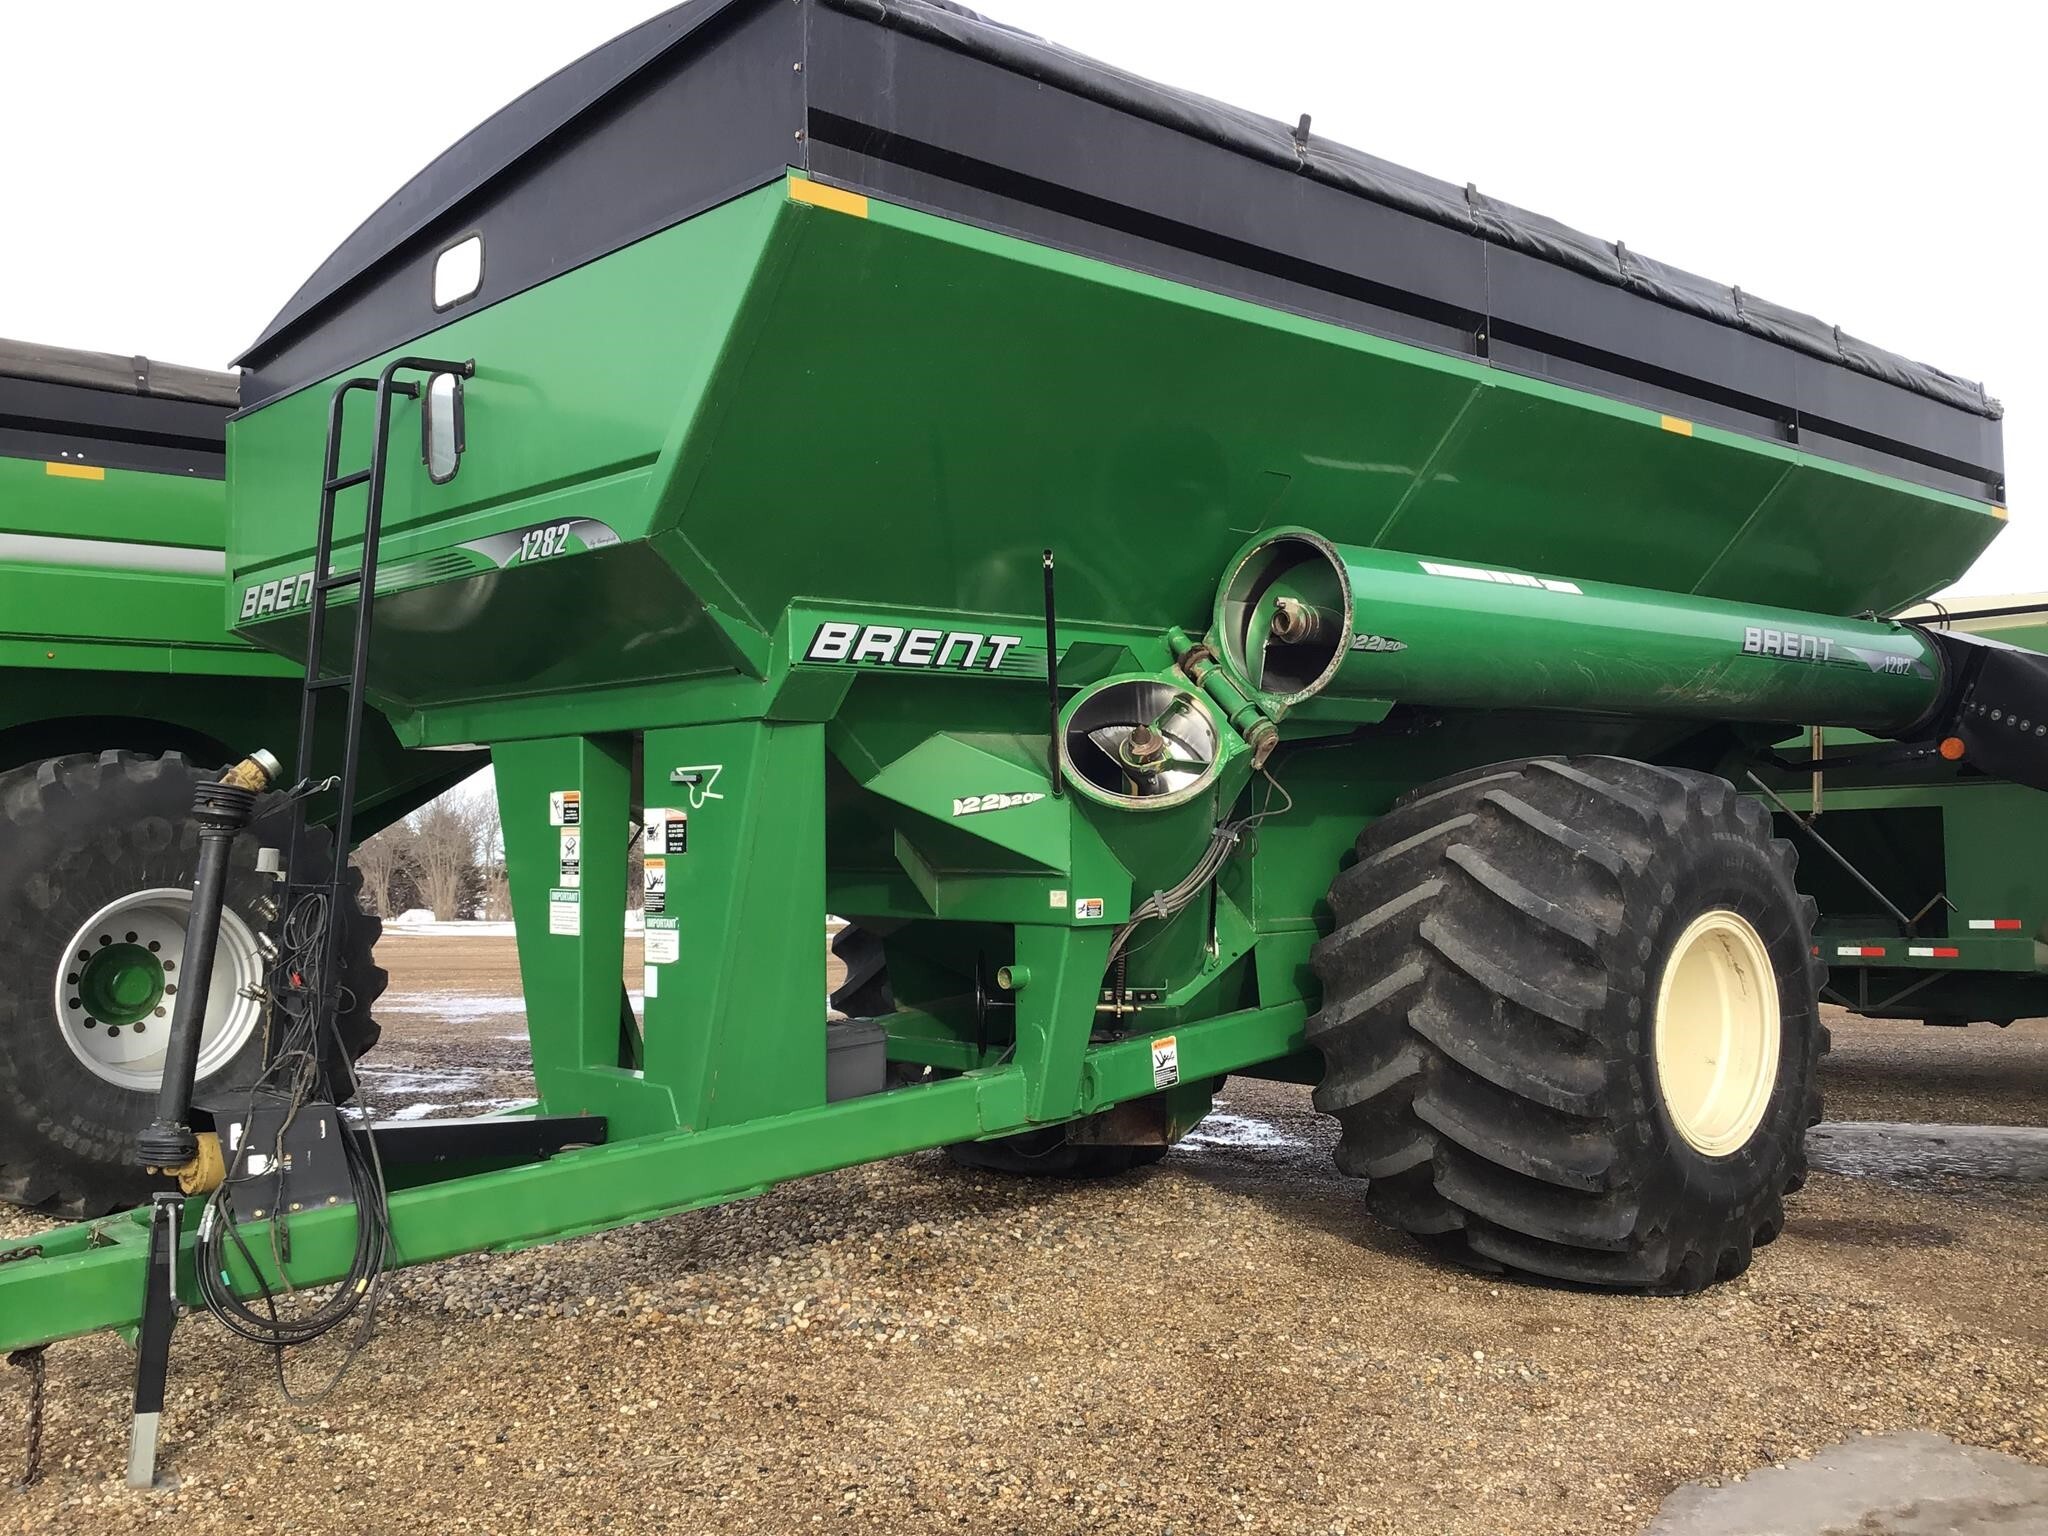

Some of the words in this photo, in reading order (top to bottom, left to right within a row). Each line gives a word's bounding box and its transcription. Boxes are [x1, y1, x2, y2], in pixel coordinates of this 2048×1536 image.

[520, 523, 571, 562] 1282
[239, 566, 336, 619] BREN
[804, 621, 1022, 672] BRENT
[1743, 626, 1835, 662] BRENT
[1884, 655, 1912, 676] 1282
